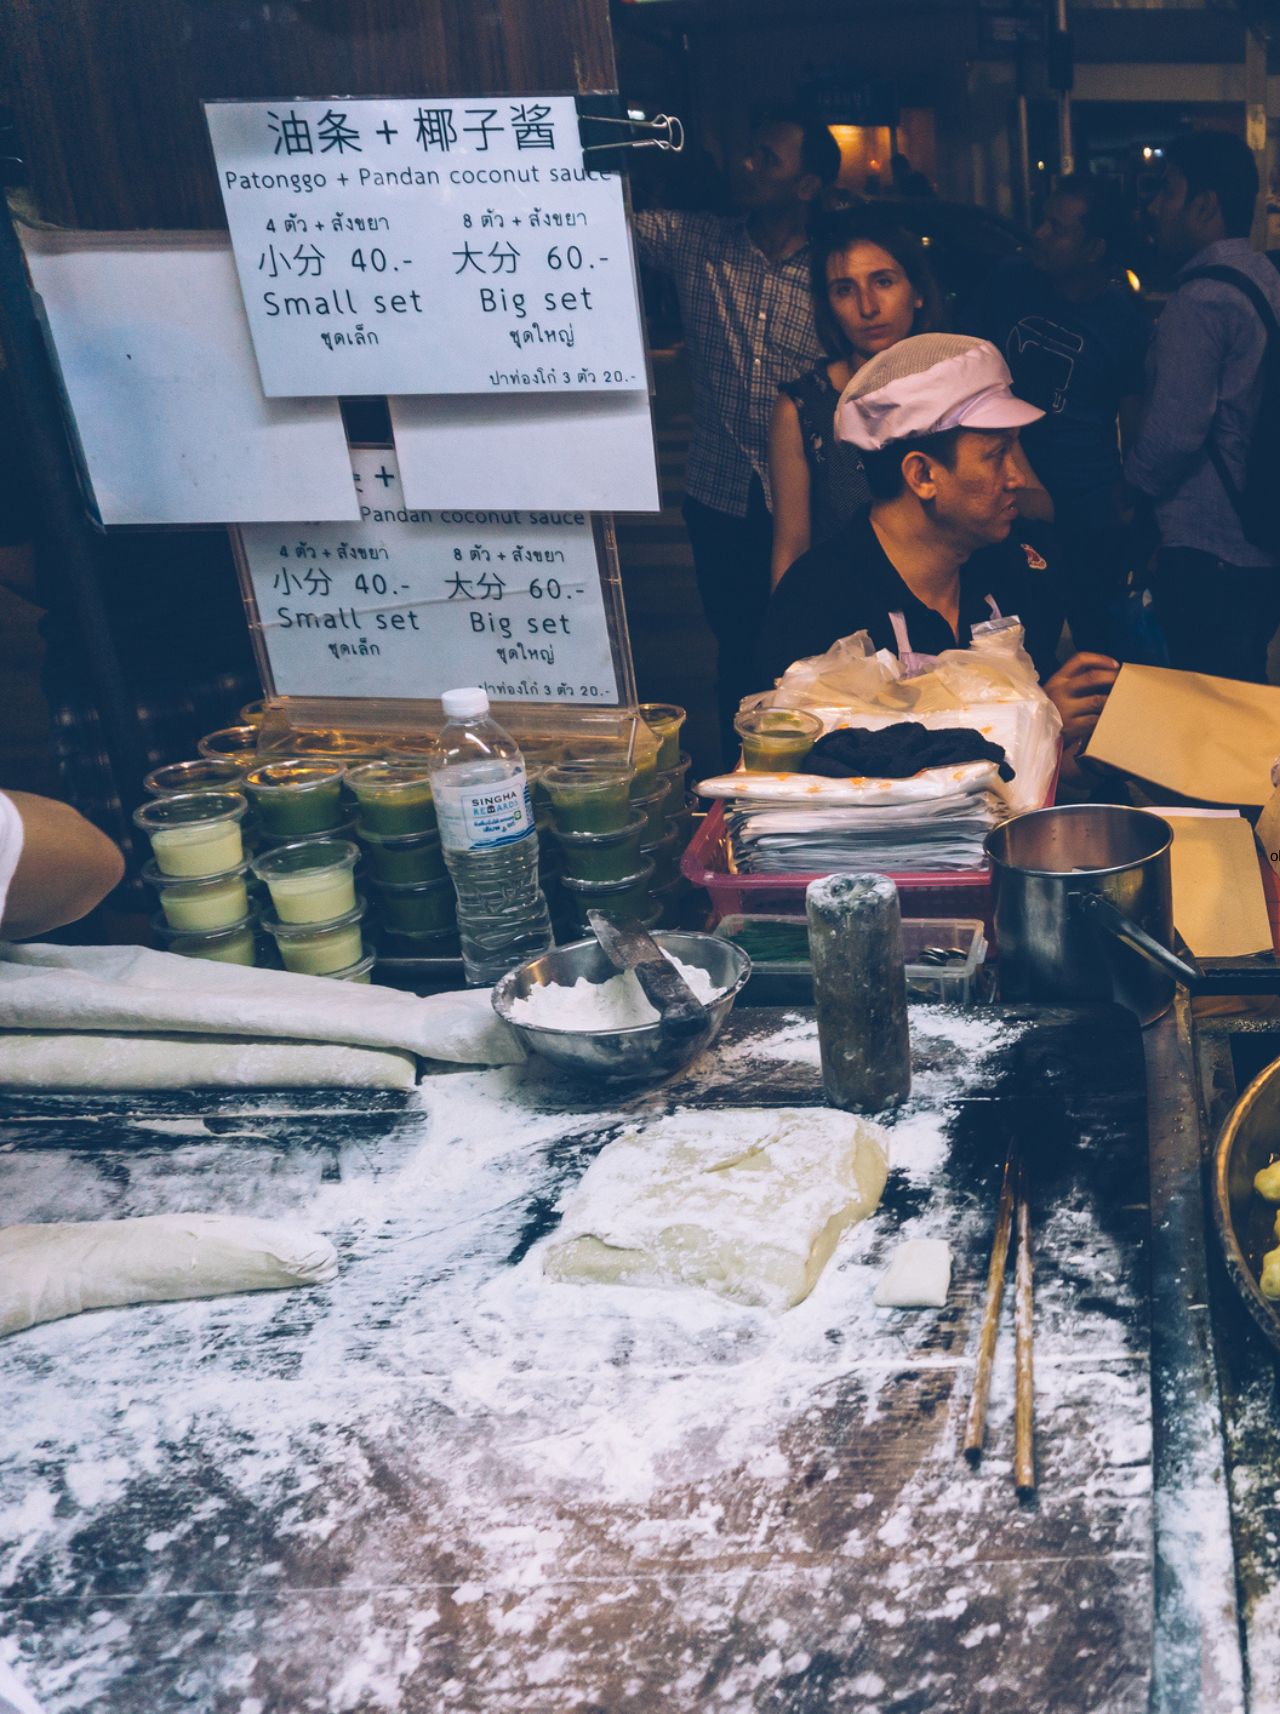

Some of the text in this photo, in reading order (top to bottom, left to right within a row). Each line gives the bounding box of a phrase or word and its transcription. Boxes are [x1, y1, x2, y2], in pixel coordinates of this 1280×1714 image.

[267, 103, 555, 155] 油条 + 椰子酱
[225, 171, 327, 193] Patonggo
[359, 166, 440, 186] Pandan
[450, 165, 539, 184] coconut
[266, 218, 276, 233] 4
[284, 213, 308, 233] ตัว
[331, 211, 390, 232] สังขยา
[463, 213, 473, 228] 8
[481, 208, 504, 228] ตัว
[529, 207, 588, 227] สังขยา
[259, 244, 412, 277] 小分 40.-
[452, 241, 608, 274] 大分 60.-
[263, 289, 423, 316] Small set
[480, 287, 593, 318] Big set
[321, 323, 379, 351] ชุดเล็ก
[509, 322, 575, 349] ชุดใหญ่
[563, 372, 571, 384] 3
[577, 367, 596, 384] ตัว
[603, 370, 637, 383] 20.-
[360, 506, 585, 525] Pandan coconut sauce
[453, 547, 462, 561] 8
[273, 567, 410, 596] 小分 40.-
[444, 571, 584, 600] 大分 60.-
[277, 607, 420, 630] Small set
[469, 611, 571, 638] Big set
[496, 642, 555, 665] ชุดใหญ่
[544, 685, 551, 696] 3
[580, 685, 610, 697] 20.-
[472, 791, 517, 806] SINGHA
